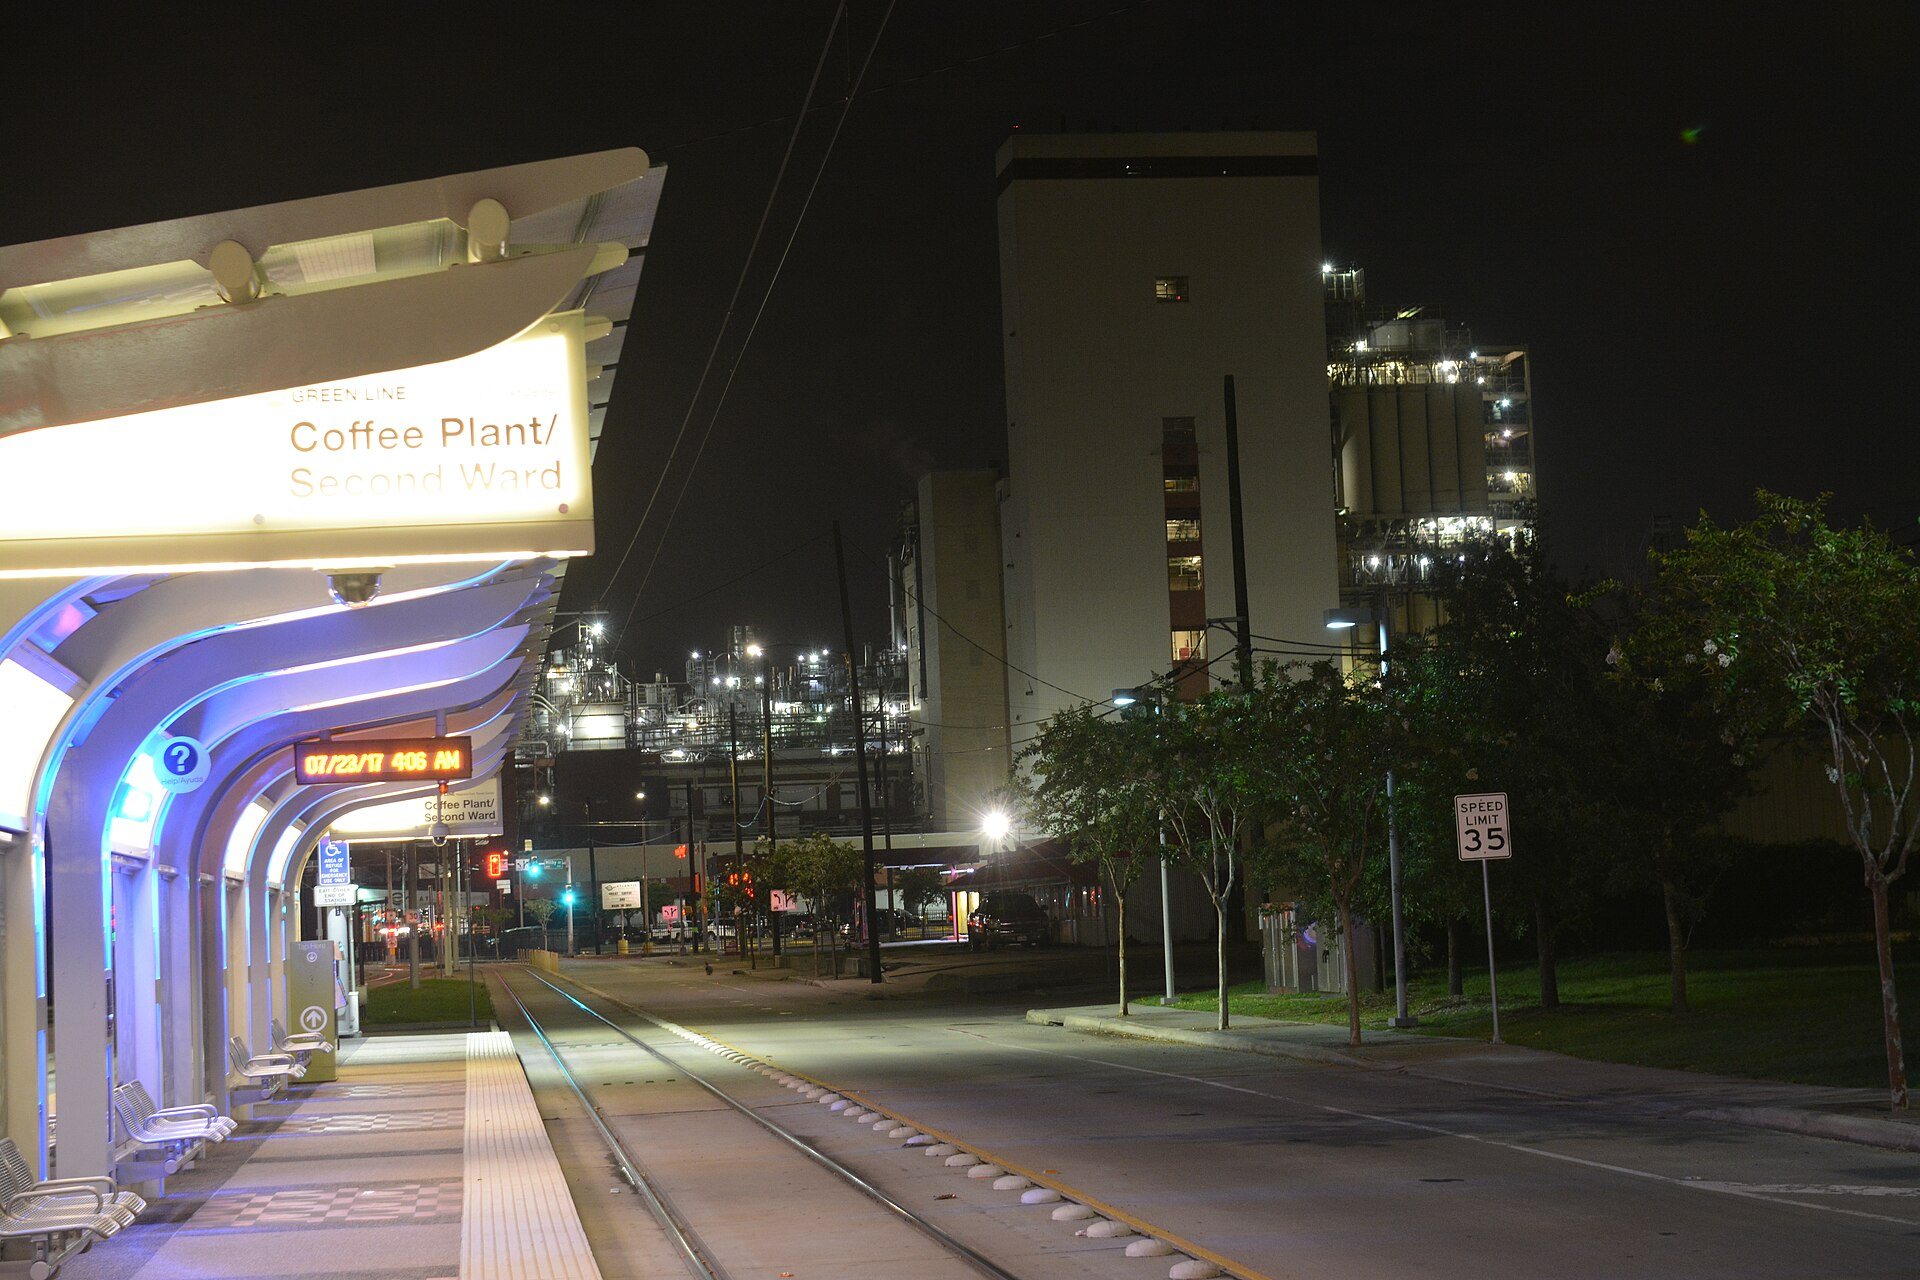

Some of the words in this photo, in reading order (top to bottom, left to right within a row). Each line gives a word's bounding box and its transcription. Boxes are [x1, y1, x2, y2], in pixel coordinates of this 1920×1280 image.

[292, 388, 357, 402] GREEN
[366, 386, 406, 400] LINE
[290, 420, 424, 452] Coffee
[441, 414, 558, 448] Plant/
[290, 464, 442, 498] Second
[460, 460, 561, 491] Ward
[305, 753, 384, 775] 07/23/17
[433, 750, 460, 770] AM
[424, 800, 460, 810] Coffee
[463, 798, 495, 809] Plant/
[1461, 801, 1503, 813] SPEED
[468, 810, 496, 820] Ward
[1466, 814, 1499, 826] LIMIT
[1464, 827, 1505, 852] 35
